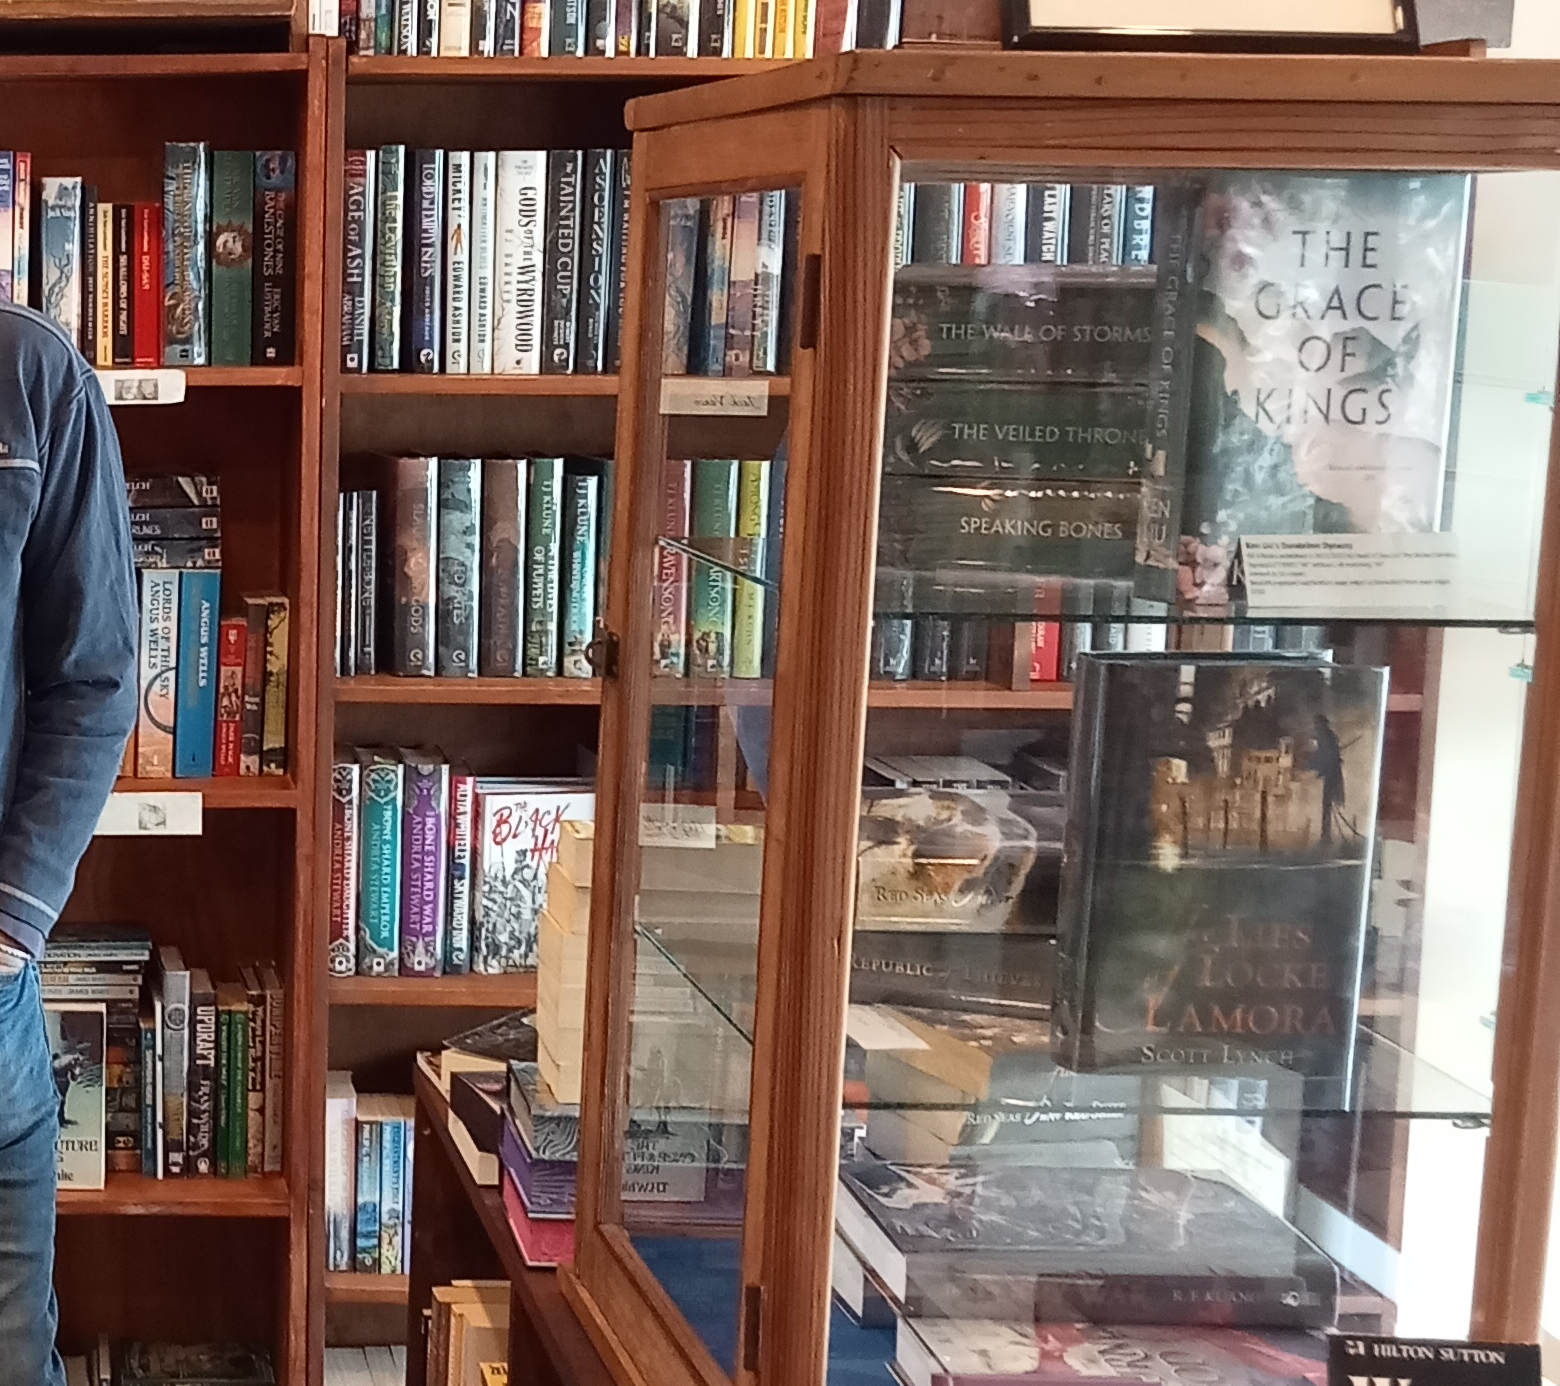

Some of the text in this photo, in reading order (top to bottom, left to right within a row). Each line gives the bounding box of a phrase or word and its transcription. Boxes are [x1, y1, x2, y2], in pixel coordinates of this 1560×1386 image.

[348, 183, 364, 221] AGE
[518, 186, 538, 228] GODS
[263, 191, 275, 275] BANESTONES
[557, 174, 574, 294] TAINTED CUP
[1292, 231, 1381, 270] THE
[346, 245, 364, 283] ASH
[263, 283, 273, 337] LUSTBADER
[271, 310, 280, 332] VAN
[514, 264, 536, 353] WYRDWOOD
[1253, 282, 1408, 322] GRACE
[939, 323, 1150, 344] THE WALL OF STORMS
[1297, 335, 1360, 373] OF
[1253, 386, 1394, 427] KINGS
[951, 423, 988, 442] THE
[994, 424, 1060, 444] VEILED
[959, 517, 1122, 540] SPEAKING BONES
[149, 580, 160, 669] ANGUS WELLS
[159, 580, 173, 700] LORDS OF THE SKY
[492, 802, 571, 847] BLACK
[409, 815, 422, 931] ANDREA STEWART
[422, 817, 436, 933] BONE SHARD WAR
[875, 885, 908, 901] RED
[1146, 995, 1335, 1034] LAMORA
[195, 1006, 215, 1067] UPDRAFT
[1141, 1044, 1293, 1064] SCOTT LYNCH
[1372, 1344, 1506, 1365] HILTON SUTTON
